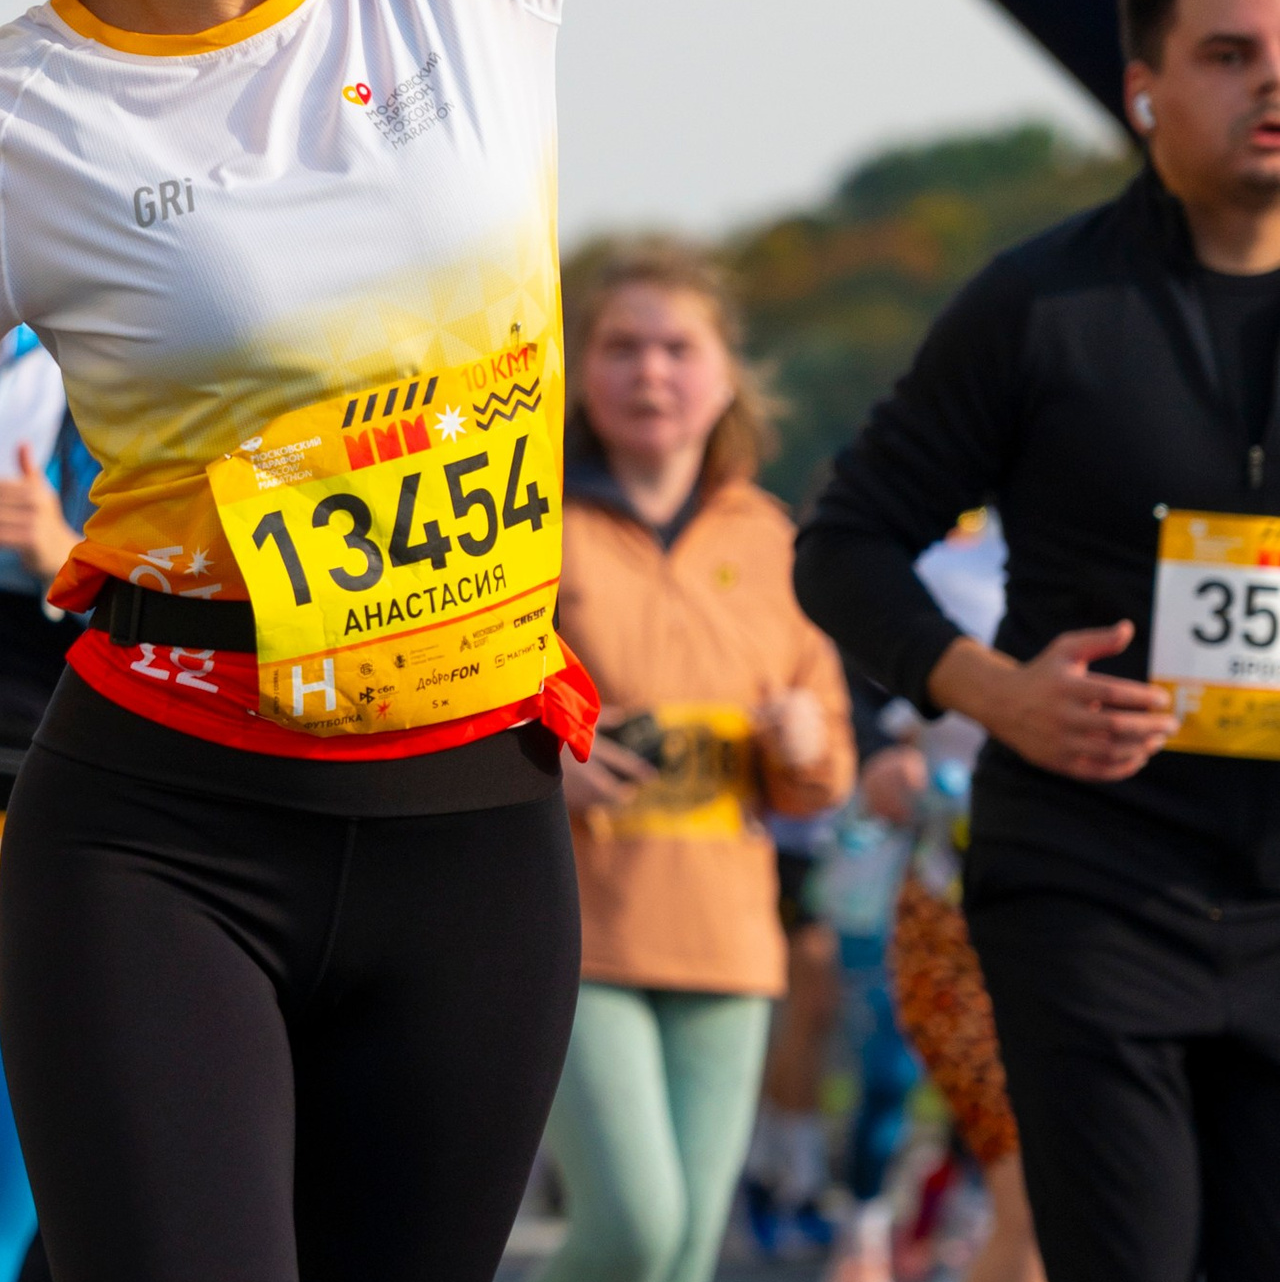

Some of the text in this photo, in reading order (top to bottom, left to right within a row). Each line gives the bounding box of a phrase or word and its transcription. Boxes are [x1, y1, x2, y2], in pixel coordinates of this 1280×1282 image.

[365, 52, 441, 120] МОСКОВСКИЙ
[374, 84, 435, 130] МАРАФОН
[382, 98, 435, 140] MOSCOW
[391, 101, 455, 150] MARATHON
[461, 363, 487, 392] 10
[250, 436, 322, 462] МОСКОВСКИЙ
[253, 452, 305, 472] МАРАФОН
[255, 464, 300, 480] MOSCOW
[258, 469, 313, 490] MARATHON
[252, 434, 550, 606] 13454
[343, 563, 508, 636] АНАСТАСИЯ
[507, 643, 536, 660] МАГНИТ
[303, 714, 363, 730] ФУТБОЛКА
